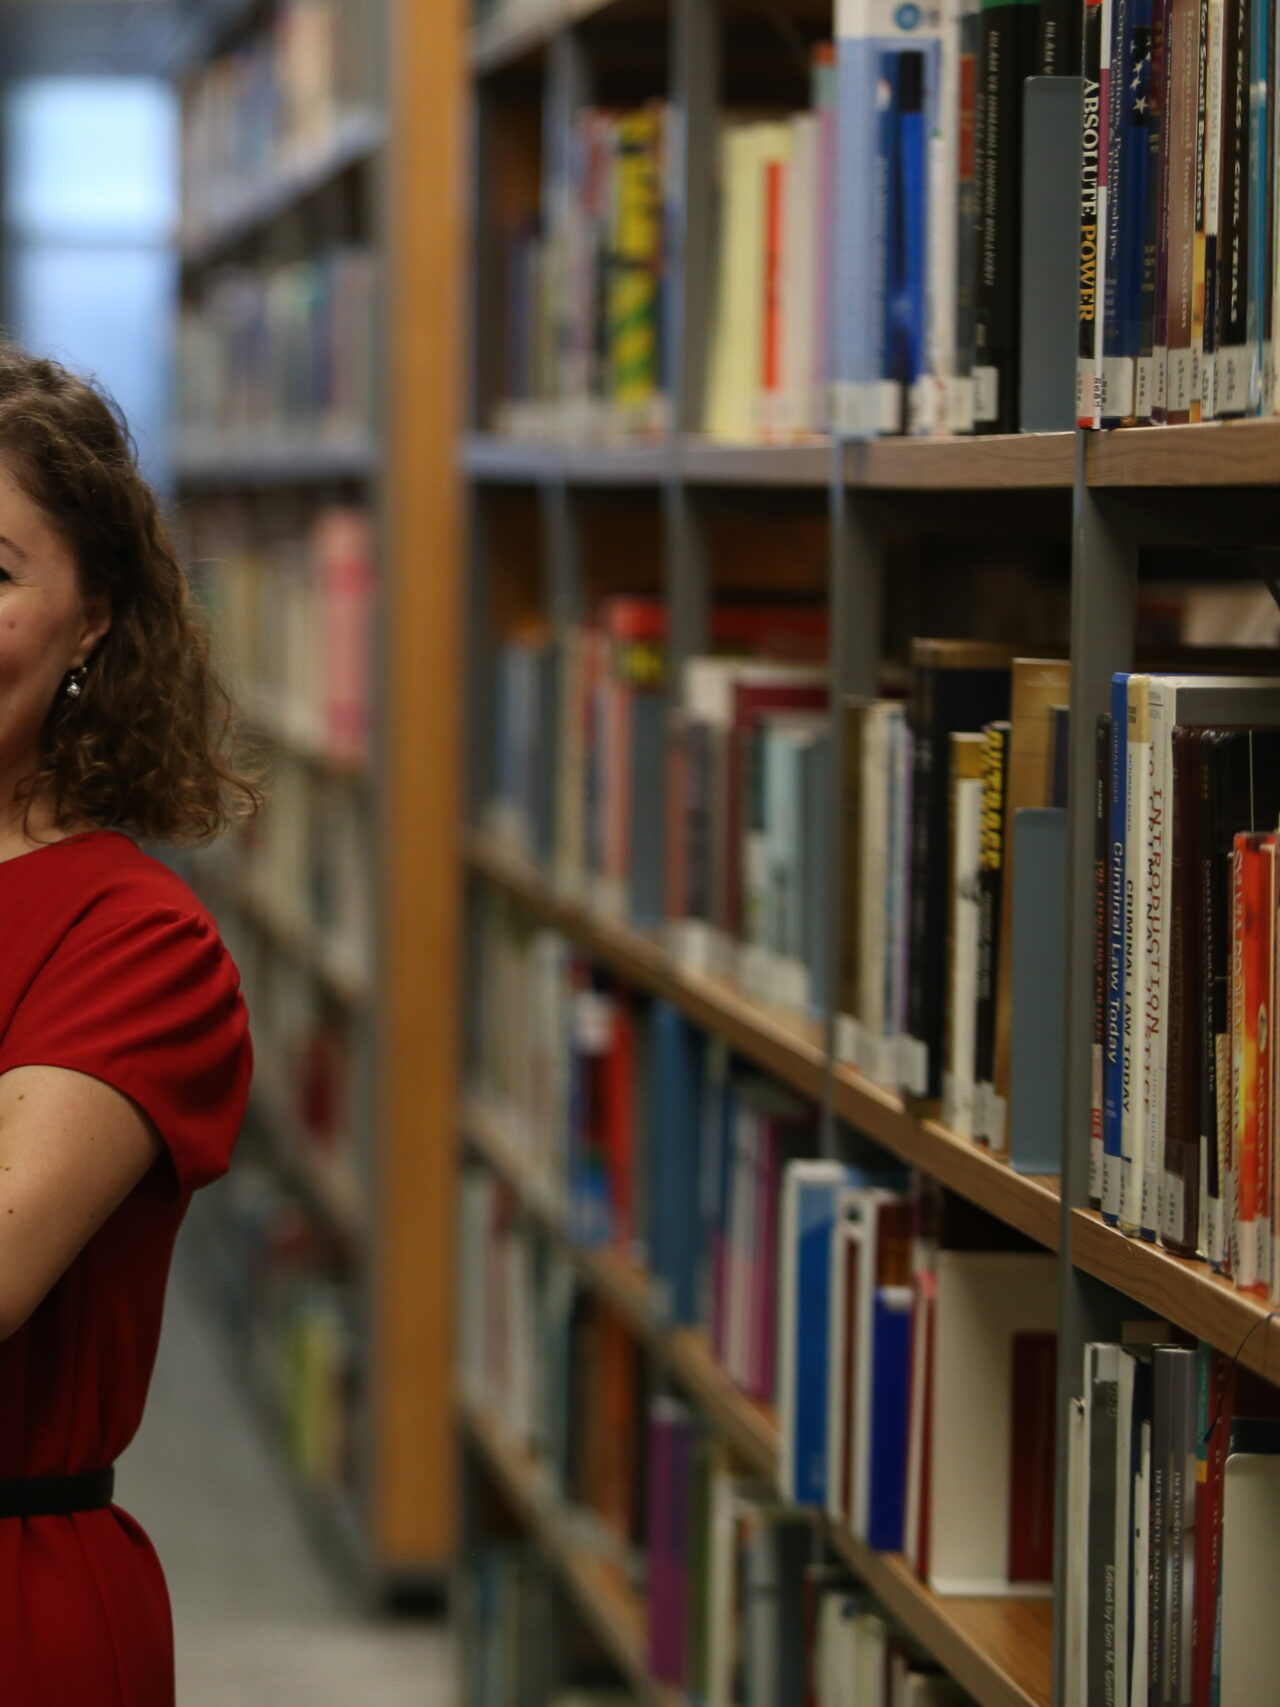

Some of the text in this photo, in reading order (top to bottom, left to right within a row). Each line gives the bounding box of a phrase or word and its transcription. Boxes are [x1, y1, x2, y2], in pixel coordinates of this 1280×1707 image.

[1184, 11, 1194, 149] International
[1199, 44, 1207, 113] Small
[1235, 49, 1243, 130] RULES
[1079, 77, 1100, 321] ABSOLUTE POWER
[1183, 156, 1192, 230] Income
[1196, 120, 1205, 223] Business
[1209, 151, 1217, 215] COURT
[1233, 159, 1241, 226] CIVIL
[1180, 241, 1191, 329] Taxation
[1230, 235, 1239, 324] TRIALS
[1107, 841, 1124, 1065] Criminal Law Today
[1150, 788, 1163, 1036] INTRODUCTION
[1205, 859, 1213, 988] Constitutional
[1123, 879, 1134, 1114] CRIMINAL LAW TODAY
[1102, 1605, 1114, 1620] by
[1104, 1564, 1115, 1603] Edited
[1104, 1623, 1115, 1648] Don
[1152, 1619, 1160, 1683] AVRUPA
